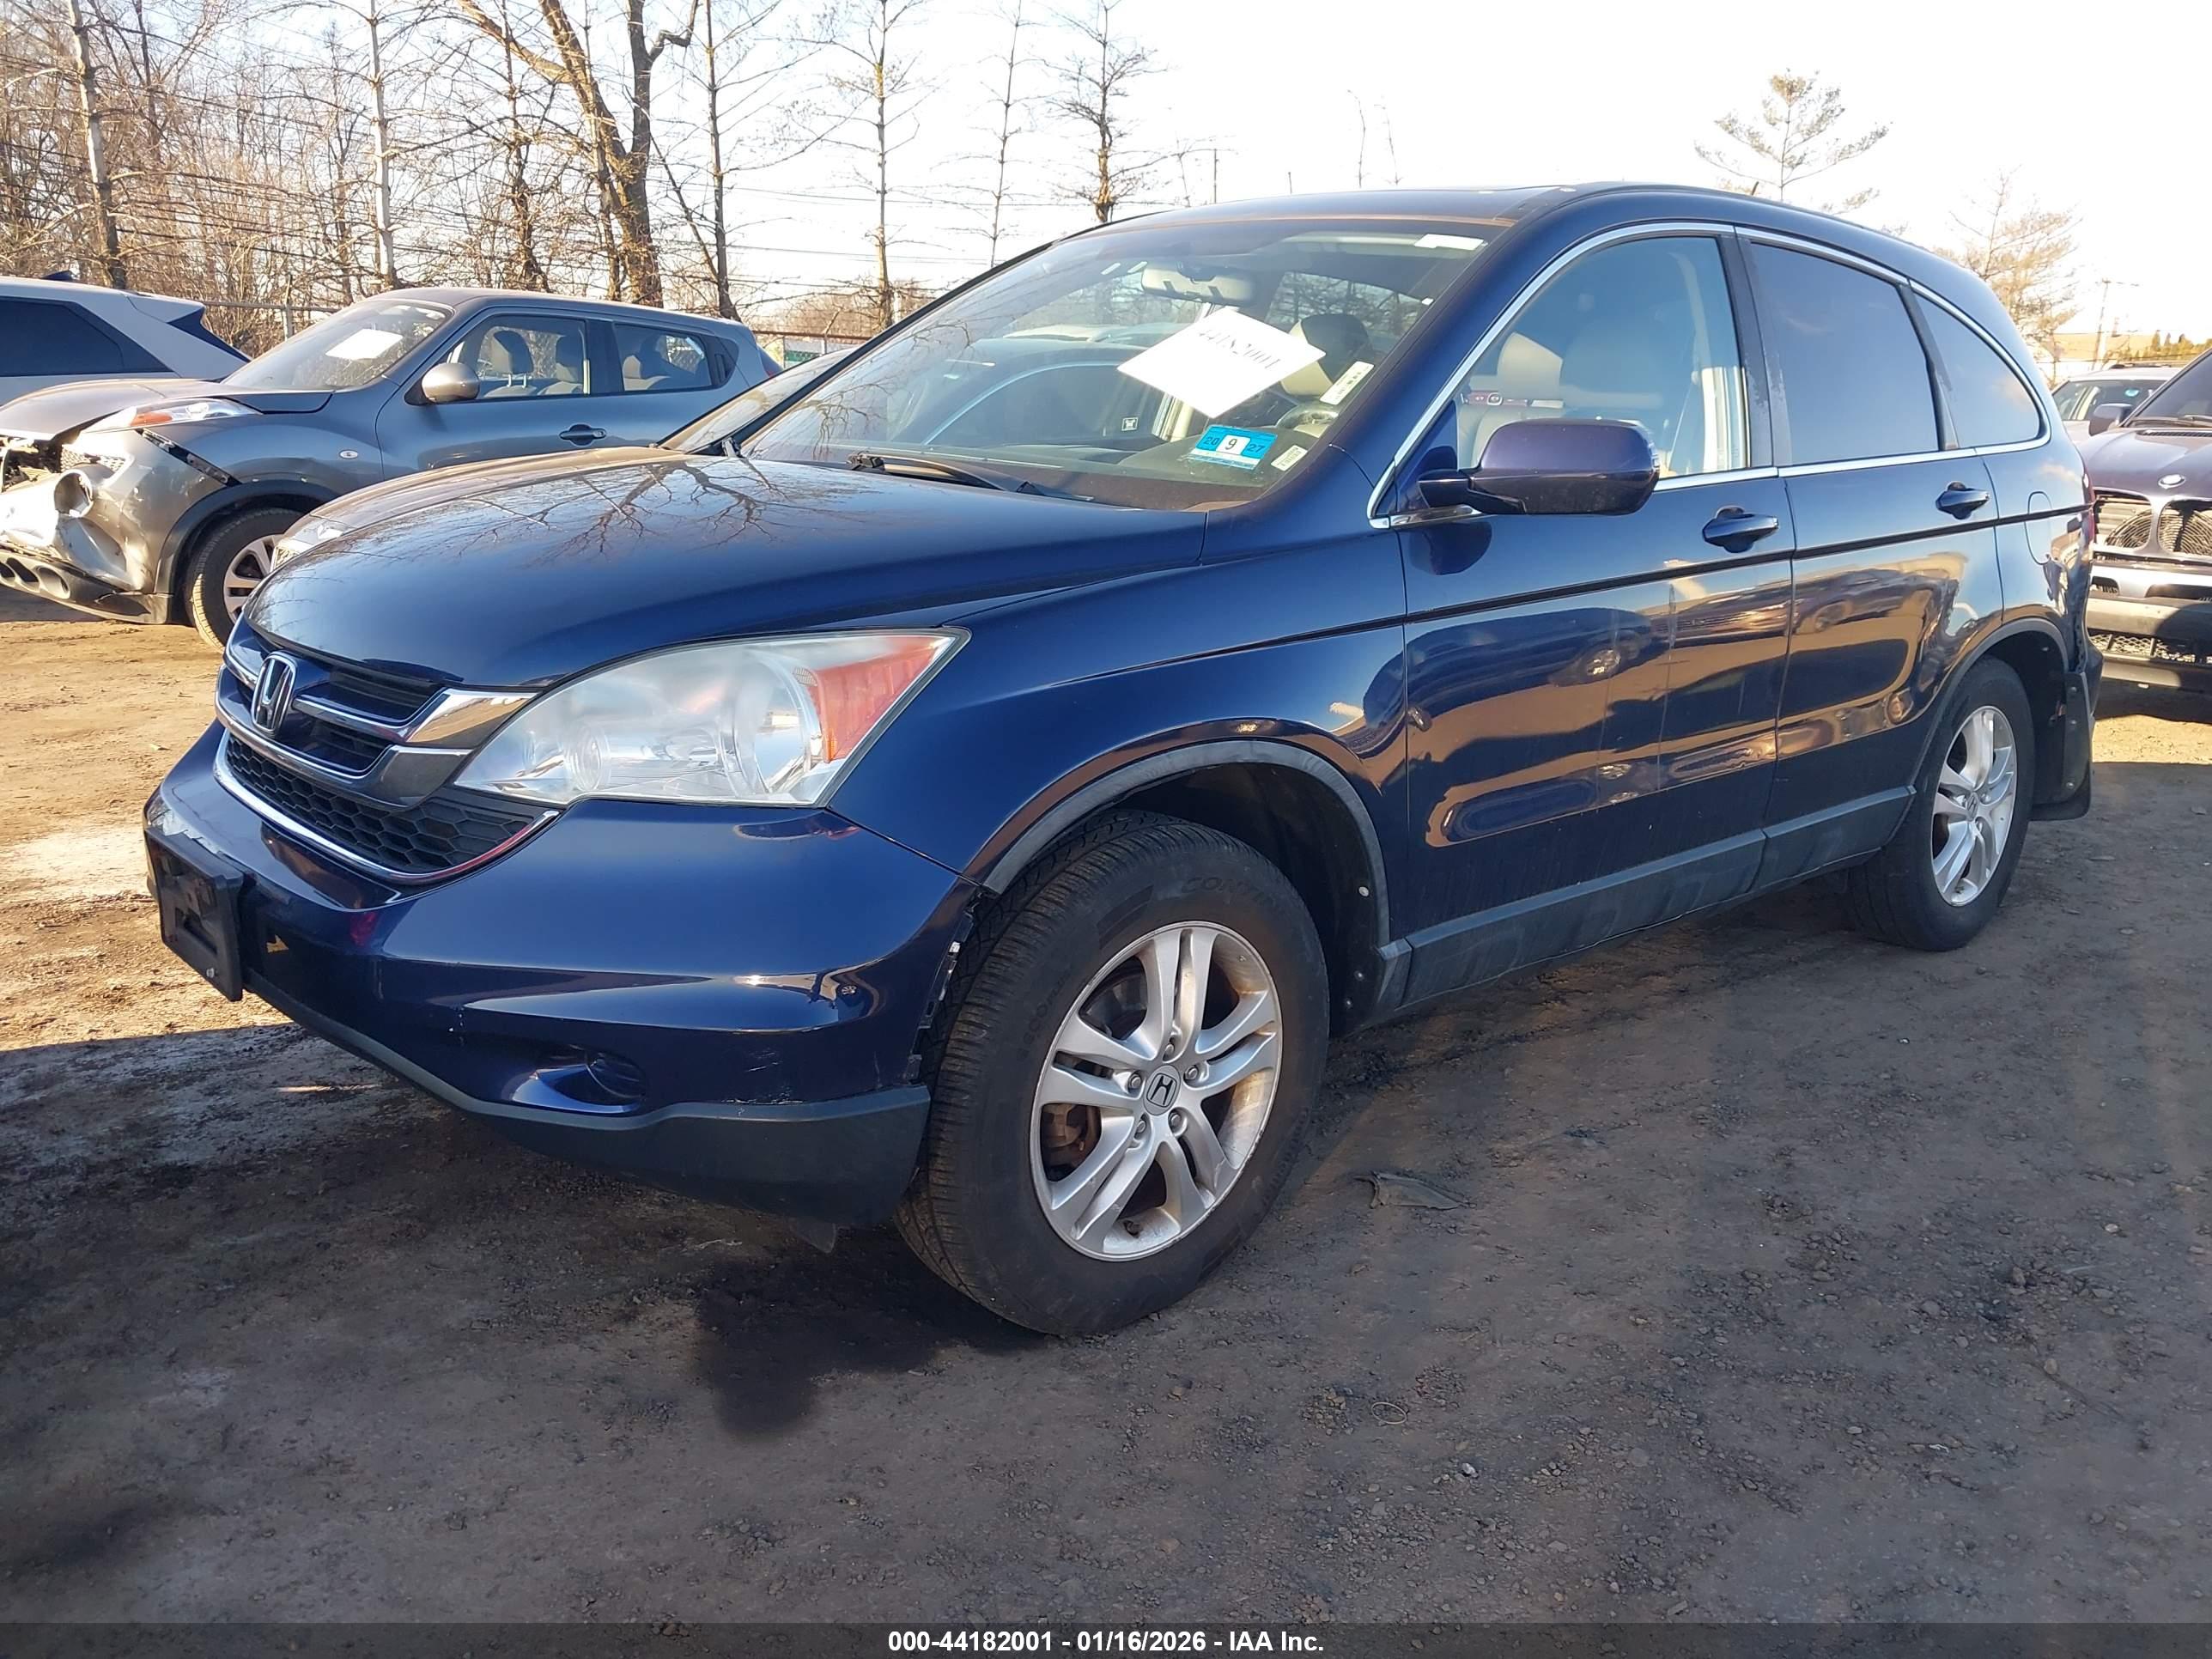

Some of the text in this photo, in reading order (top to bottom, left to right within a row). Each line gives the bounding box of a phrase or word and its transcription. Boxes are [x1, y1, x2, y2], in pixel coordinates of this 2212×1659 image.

[1203, 435, 1267, 453] 20 9 27
